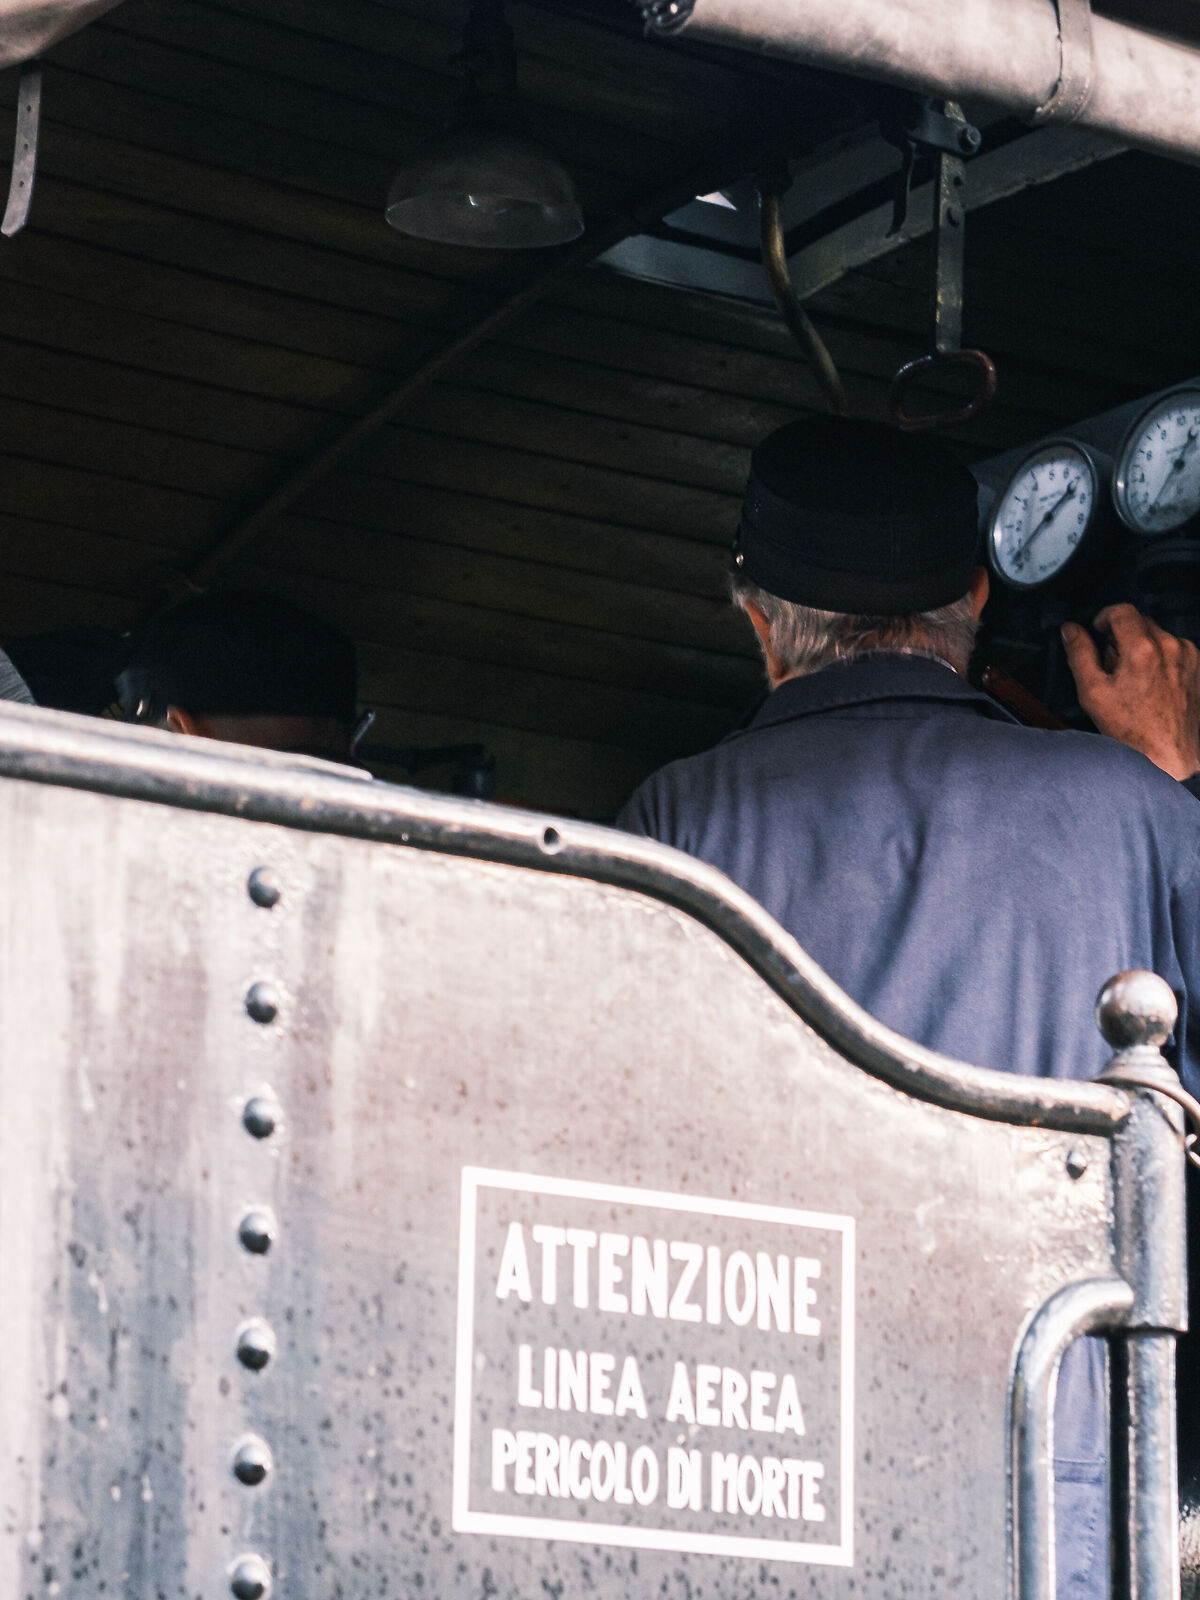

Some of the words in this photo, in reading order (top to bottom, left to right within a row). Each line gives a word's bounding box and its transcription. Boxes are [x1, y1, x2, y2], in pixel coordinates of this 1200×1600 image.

[496, 1221, 822, 1337] ATTENZIONE
[518, 1344, 648, 1419] LINEA
[666, 1361, 806, 1436] AEREA
[491, 1428, 660, 1506] PERICOLO
[667, 1447, 702, 1511] DI
[711, 1451, 826, 1522] MORTE
